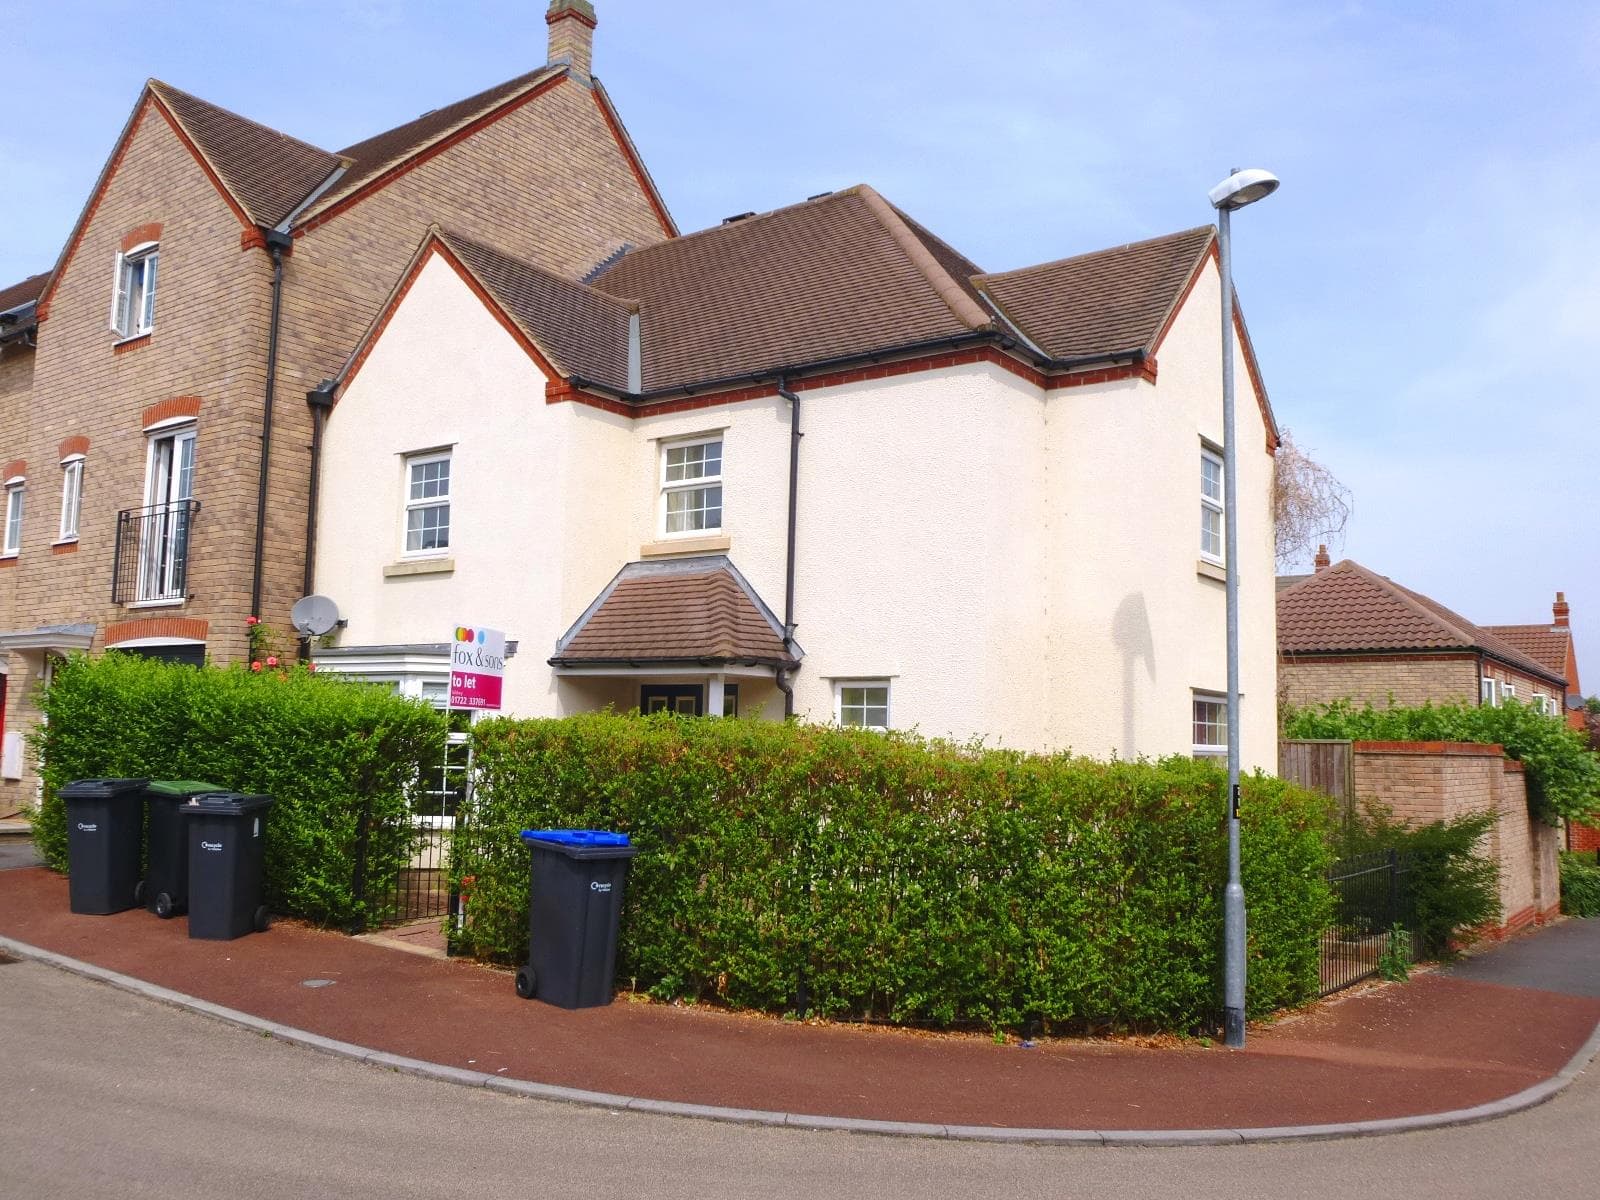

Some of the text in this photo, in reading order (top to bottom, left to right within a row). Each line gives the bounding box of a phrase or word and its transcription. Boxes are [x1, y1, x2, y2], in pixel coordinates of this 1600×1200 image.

[453, 643, 503, 670] fox & sons
[452, 674, 476, 689] to let
